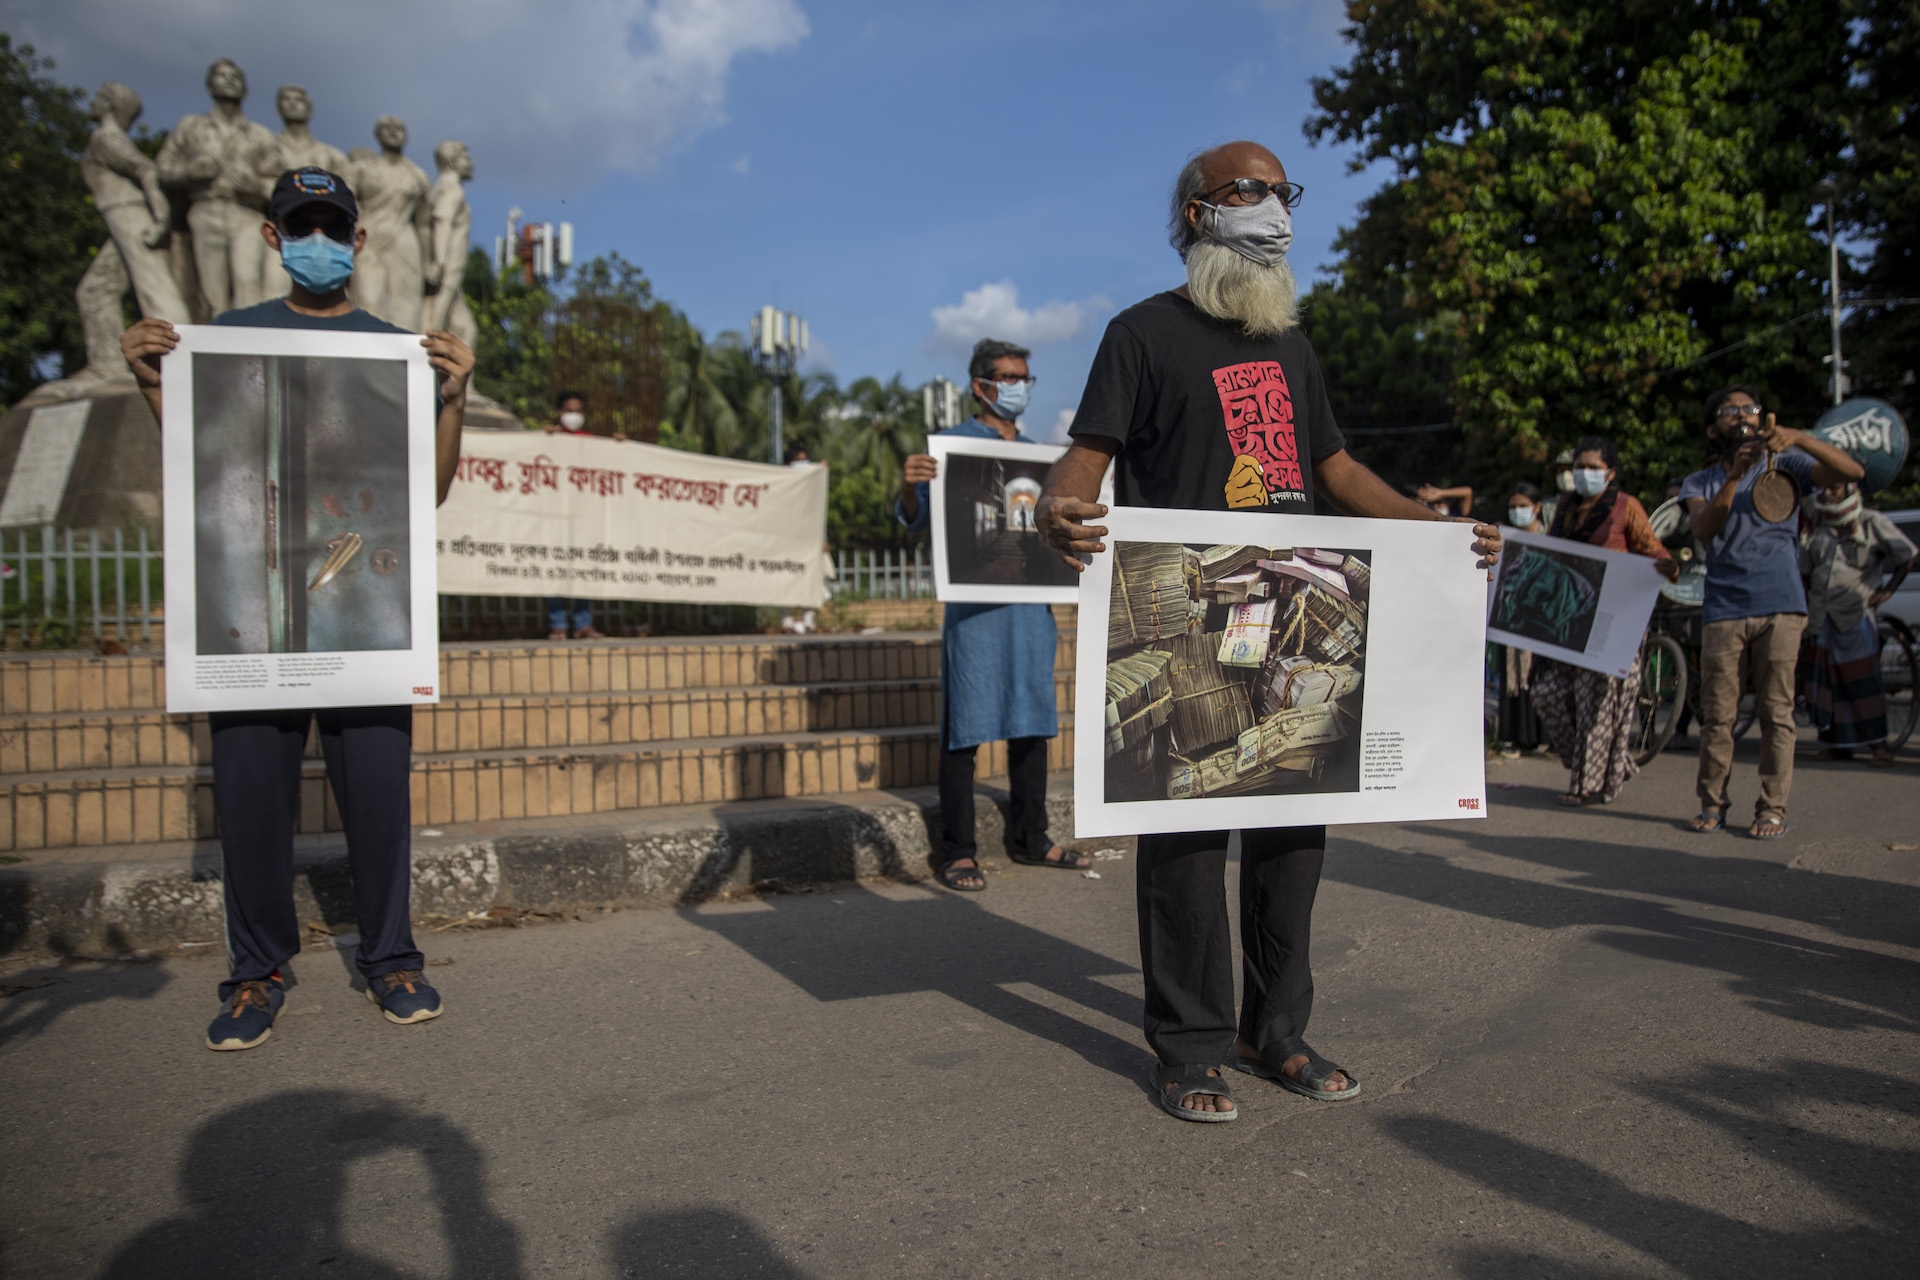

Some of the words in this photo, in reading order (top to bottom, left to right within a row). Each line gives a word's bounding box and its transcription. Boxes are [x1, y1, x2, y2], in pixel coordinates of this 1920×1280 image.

[517, 454, 562, 495] তুমি
[567, 465, 626, 497] কান্না
[449, 534, 505, 559] প্রতিবাদে
[1458, 798, 1480, 808] CROSS
